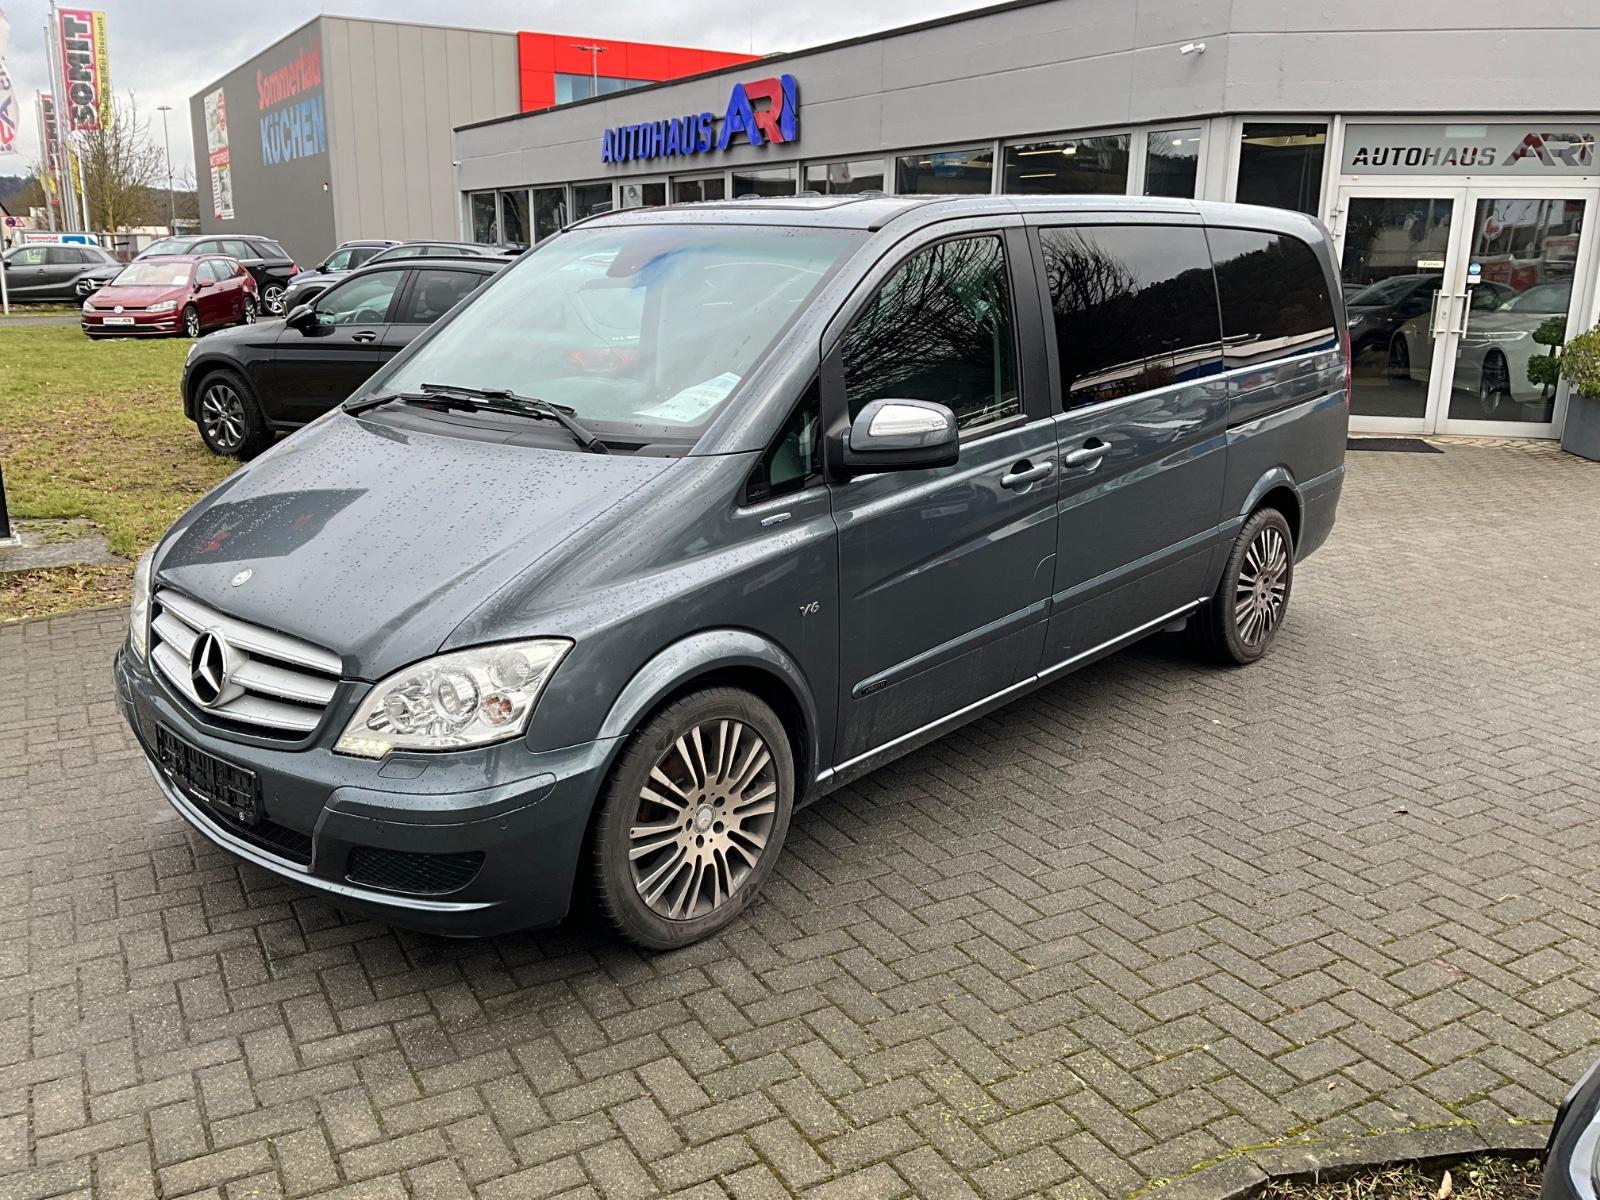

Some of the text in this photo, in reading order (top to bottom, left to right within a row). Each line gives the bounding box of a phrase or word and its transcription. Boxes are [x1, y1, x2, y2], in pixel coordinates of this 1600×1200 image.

[63, 15, 97, 129] SOMIT
[260, 95, 327, 166] KÜCHEN
[601, 74, 799, 163] AUTOHAUS ARI
[1352, 132, 1595, 167] AUTOHAUS ARI
[800, 601, 820, 617] V6
